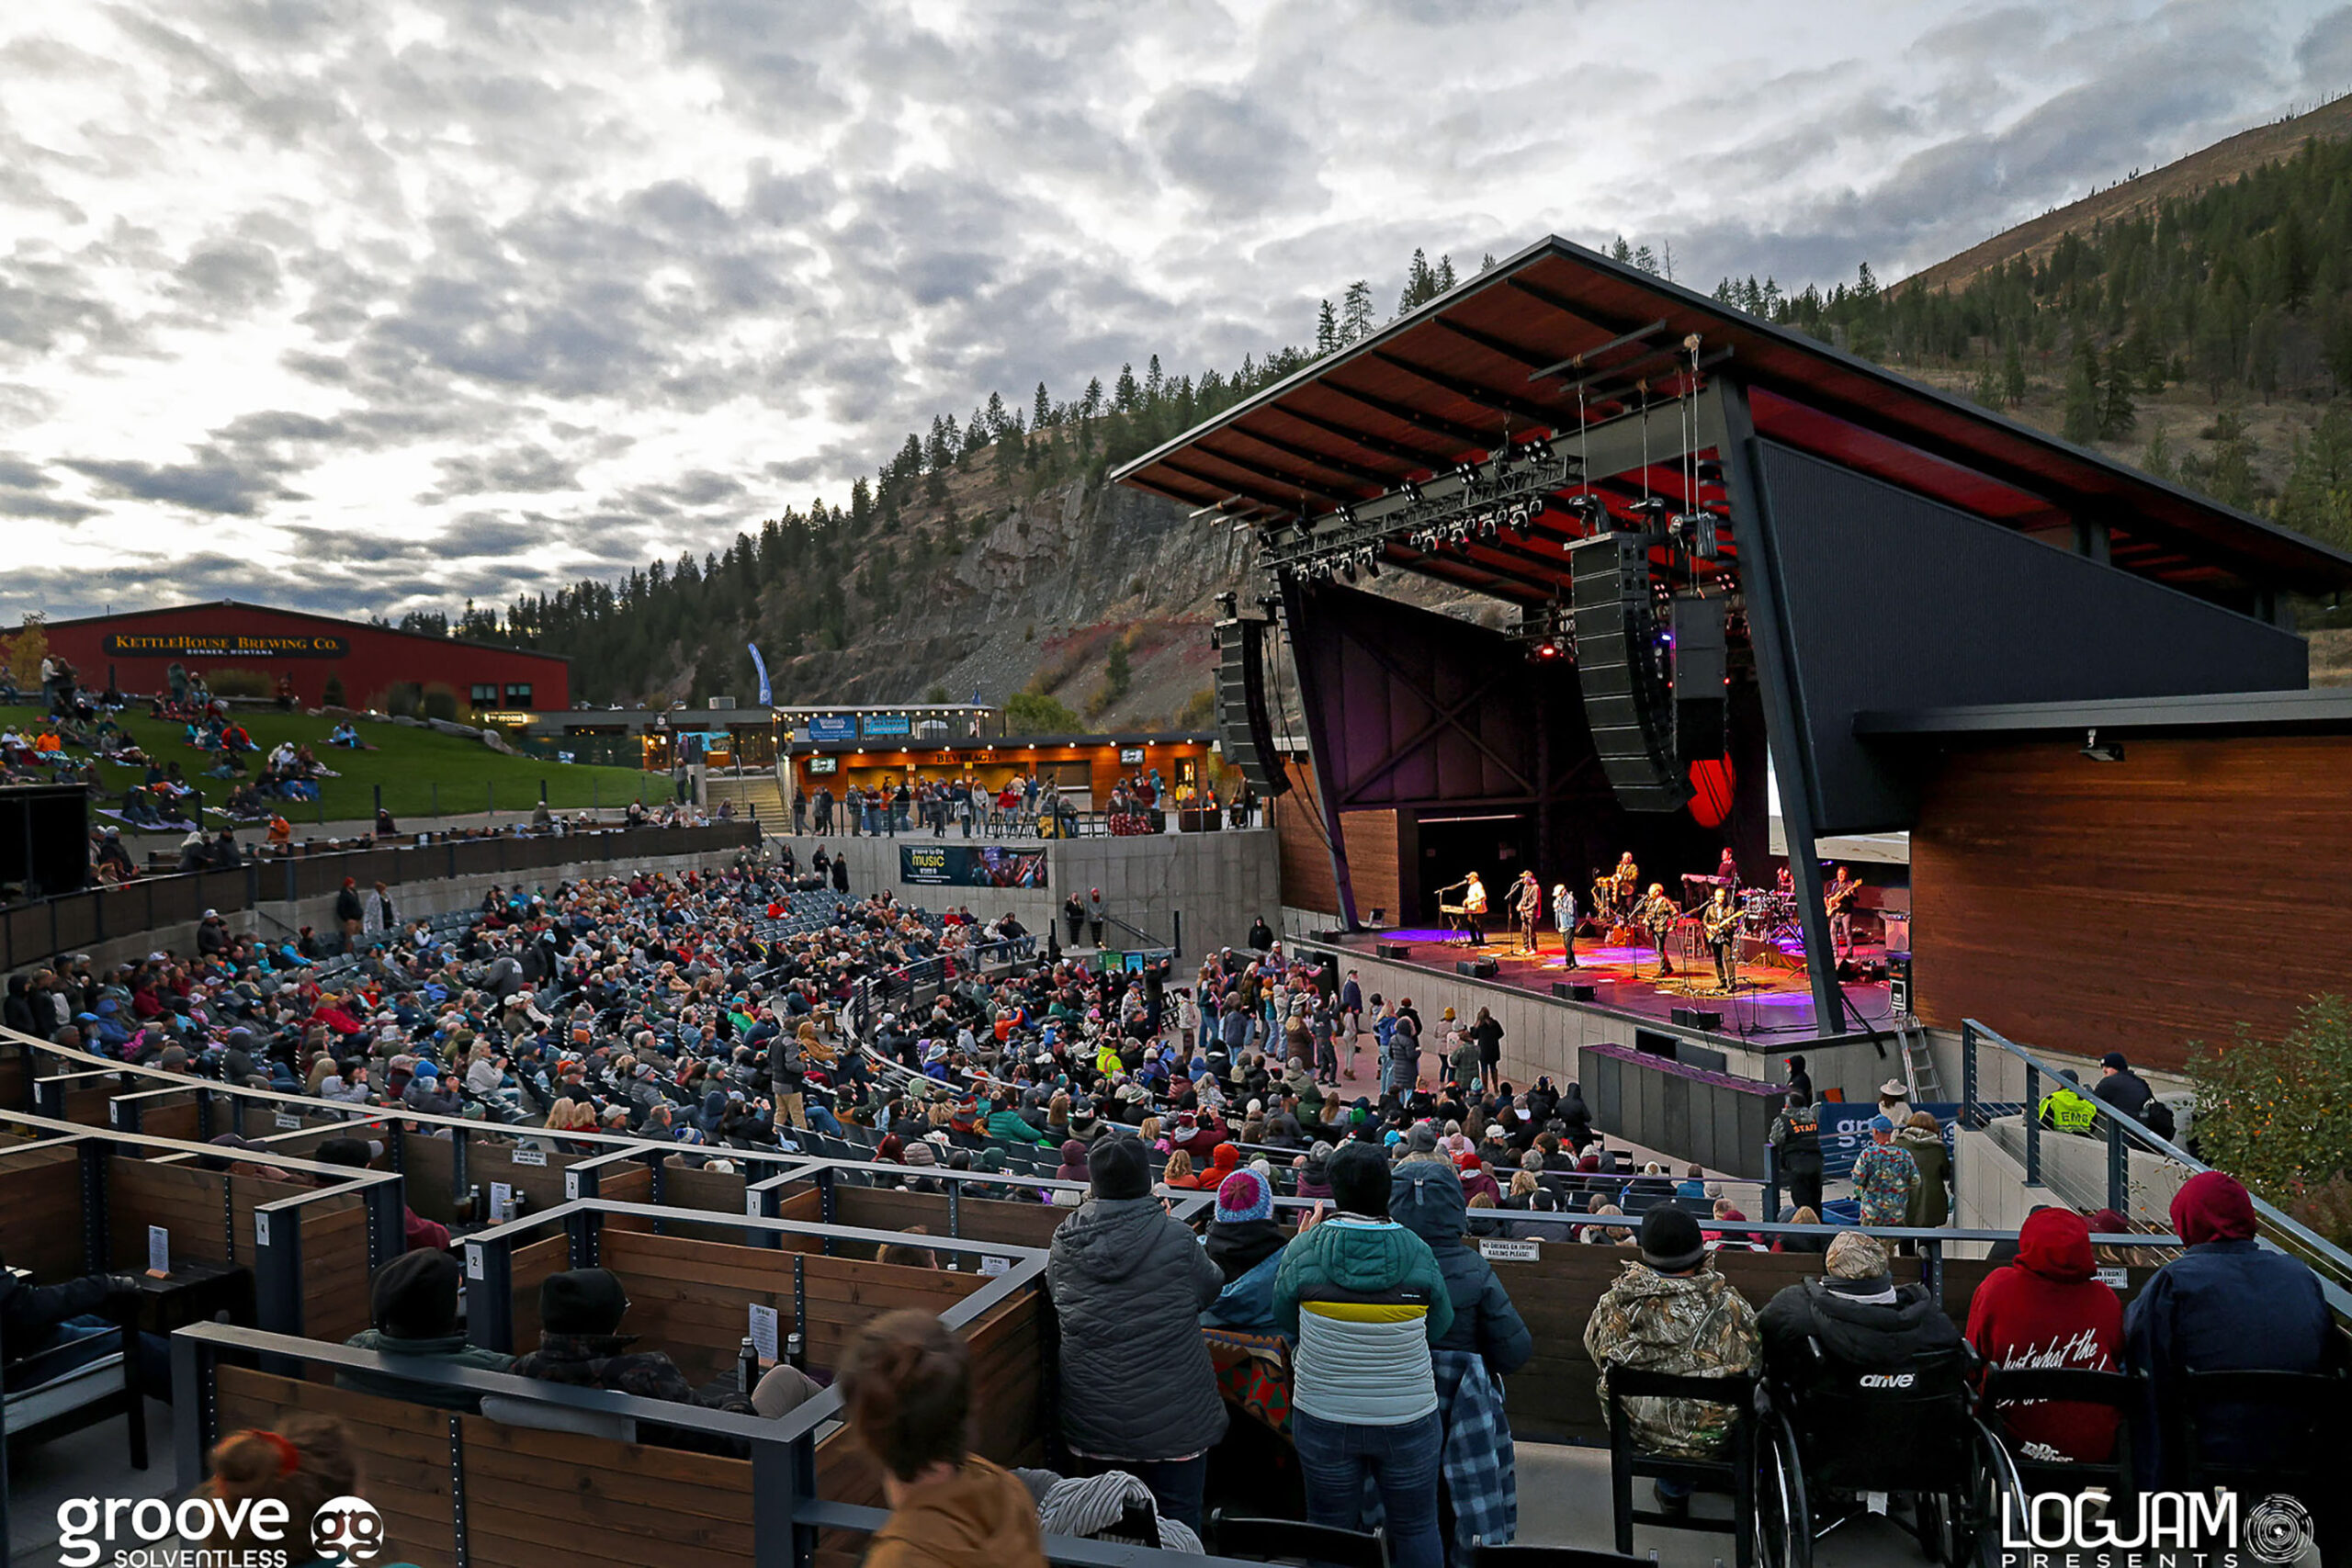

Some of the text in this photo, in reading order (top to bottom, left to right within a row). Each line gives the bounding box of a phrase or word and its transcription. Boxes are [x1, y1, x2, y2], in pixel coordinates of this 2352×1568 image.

[238, 637, 307, 649] BREWING
[911, 855, 944, 867] MUSIC
[472, 1256, 478, 1267] 2
[2030, 1336, 2078, 1368] what
[2073, 1328, 2098, 1361] the
